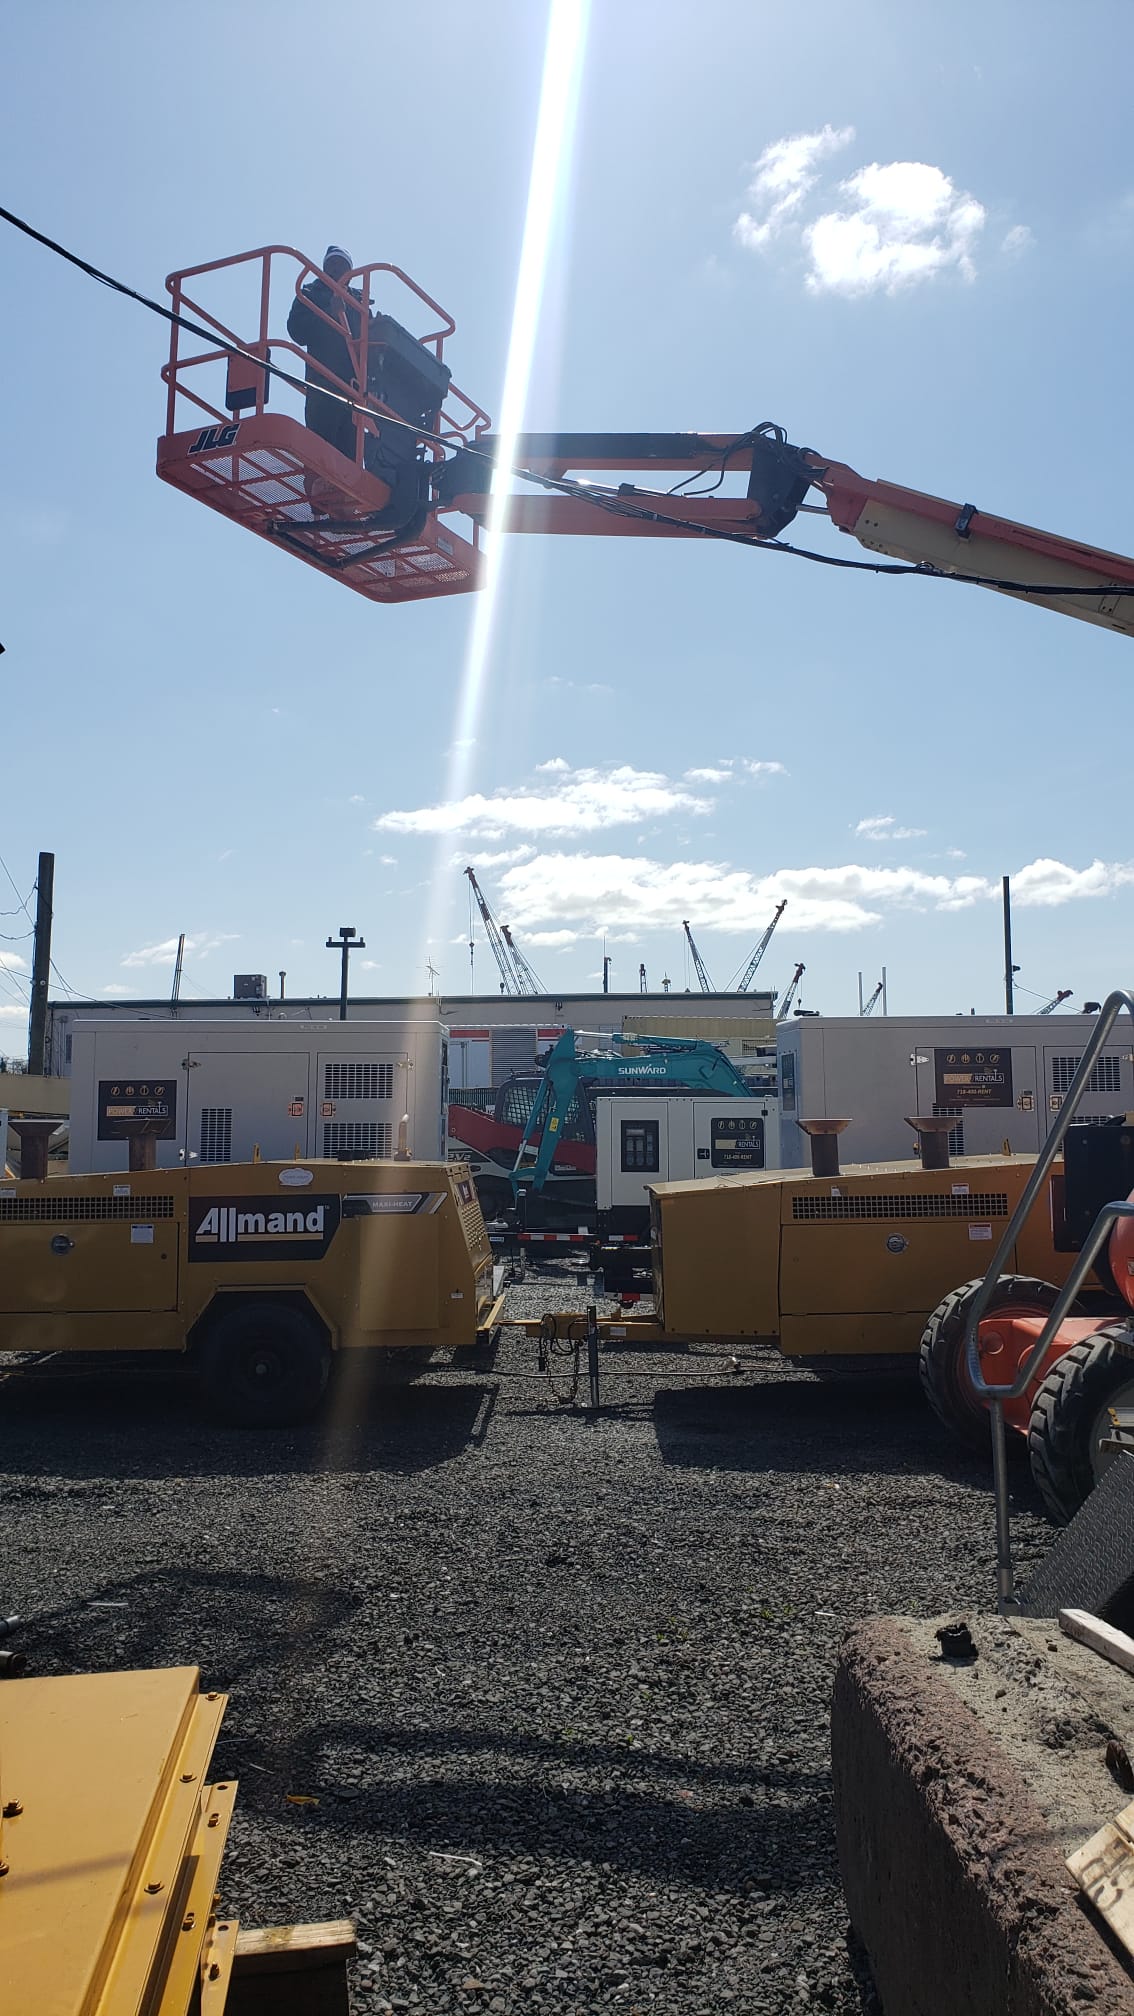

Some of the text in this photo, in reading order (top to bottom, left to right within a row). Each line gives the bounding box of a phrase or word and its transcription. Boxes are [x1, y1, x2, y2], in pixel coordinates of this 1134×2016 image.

[187, 423, 241, 456] JLG
[618, 1064, 666, 1075] SUNWARD
[138, 1106, 166, 1114] RENTALS
[196, 1205, 325, 1242] Allmand
